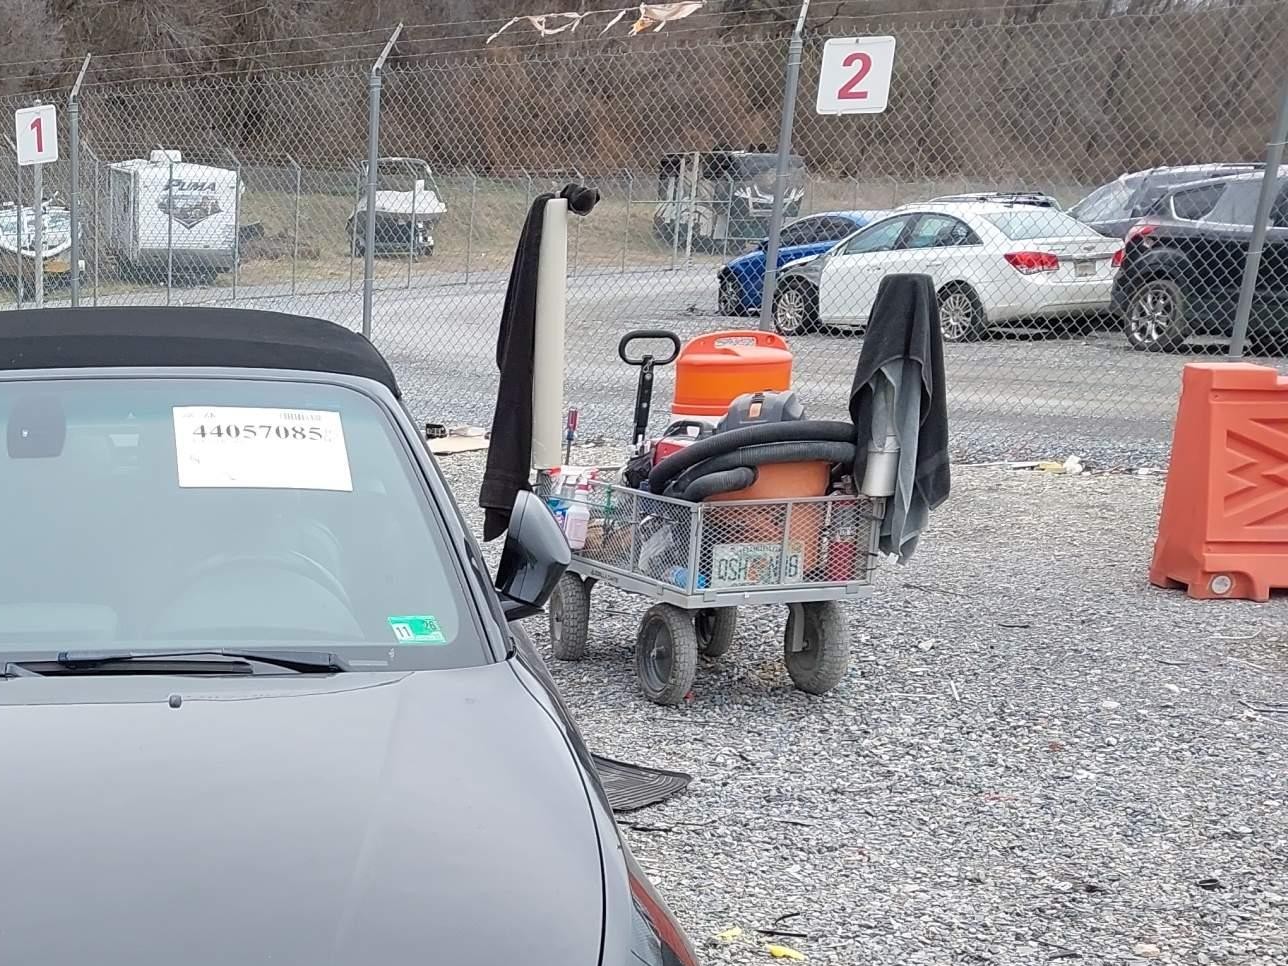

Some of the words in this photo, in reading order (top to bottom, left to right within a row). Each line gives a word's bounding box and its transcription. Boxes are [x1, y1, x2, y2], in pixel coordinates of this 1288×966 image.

[837, 52, 872, 100] 2
[30, 117, 44, 153] 1
[162, 179, 216, 191] PUMA
[192, 424, 323, 441] 44057085
